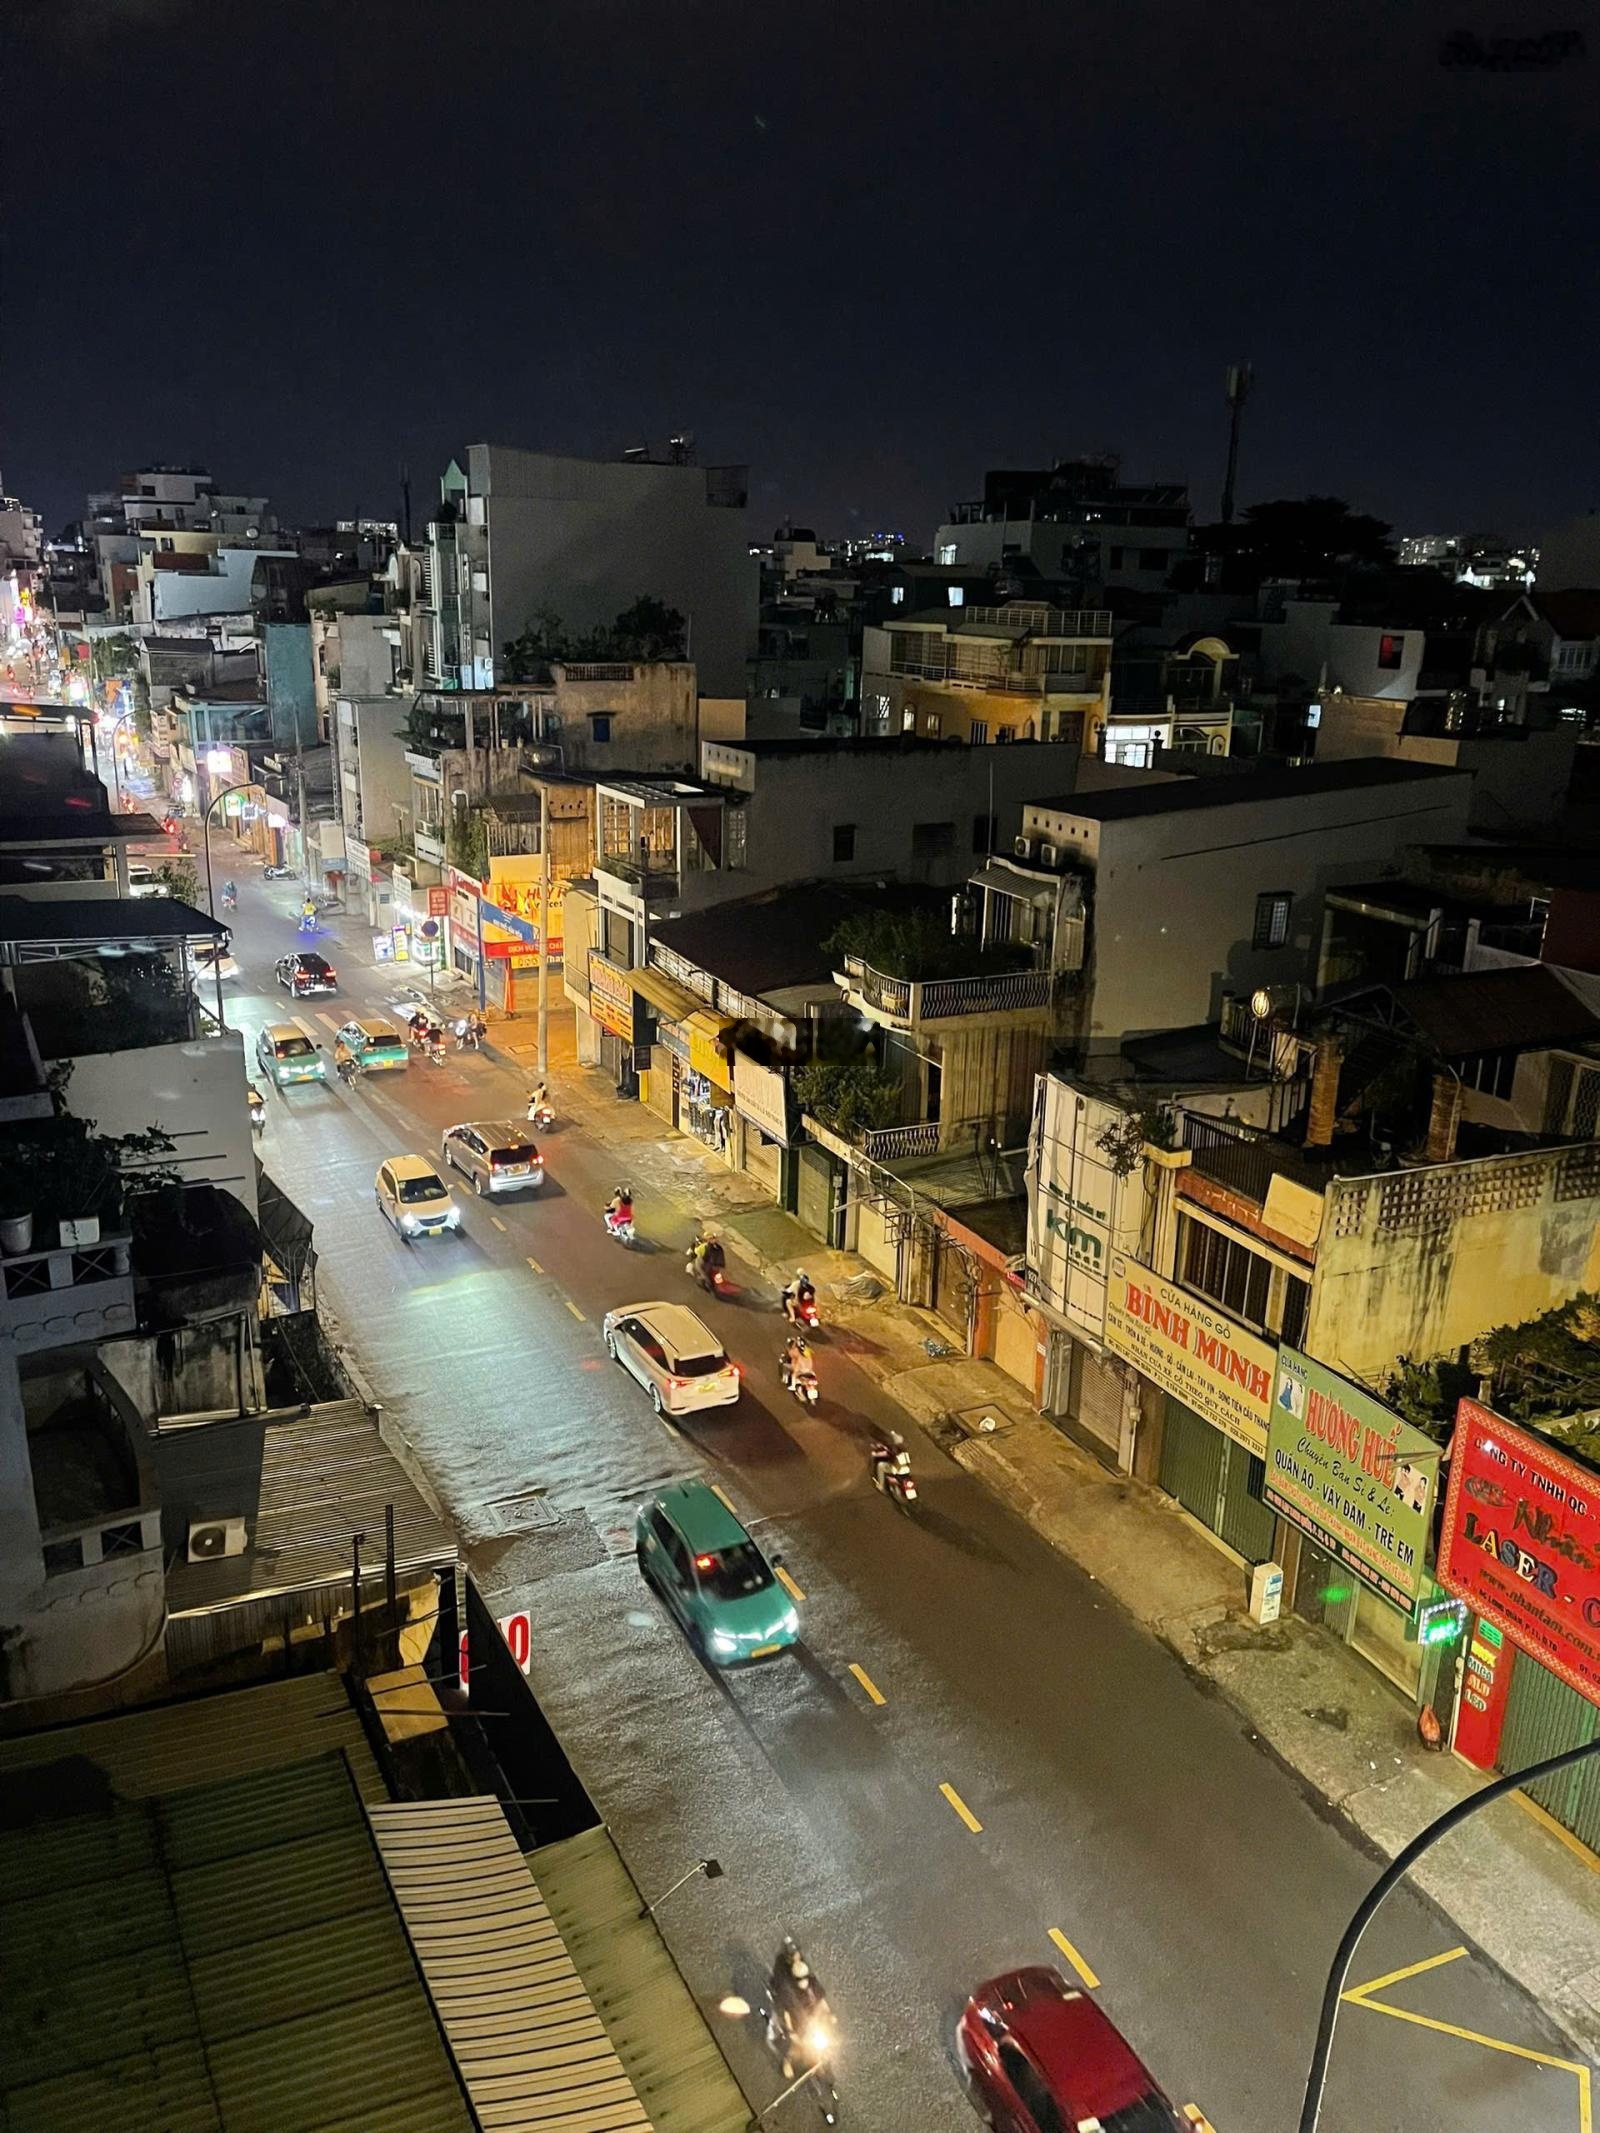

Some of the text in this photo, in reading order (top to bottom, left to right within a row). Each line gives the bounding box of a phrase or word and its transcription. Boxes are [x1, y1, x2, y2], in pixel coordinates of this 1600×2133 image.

[1047, 1208, 1101, 1258] kim
[1126, 1282, 1191, 1349] BÌNH
[1192, 1326, 1271, 1403] MINH
[1183, 1302, 1212, 1327] HÀNG
[1305, 1387, 1361, 1463] HƯƠNG
[1275, 1448, 1299, 1478] QUẦN
[1300, 1464, 1313, 1489] ÁO
[1322, 1483, 1341, 1509] VÁY
[1342, 1499, 1365, 1529] ĐẦM
[1375, 1522, 1394, 1551] TRẺ
[1397, 1540, 1413, 1566] EM
[1367, 1487, 1375, 1502] &
[1474, 1440, 1507, 1465] CNG
[1510, 1457, 1527, 1477] TY
[1531, 1471, 1565, 1502] TNHH
[1568, 1495, 1587, 1515] QC
[1463, 1512, 1557, 1599] LASER
